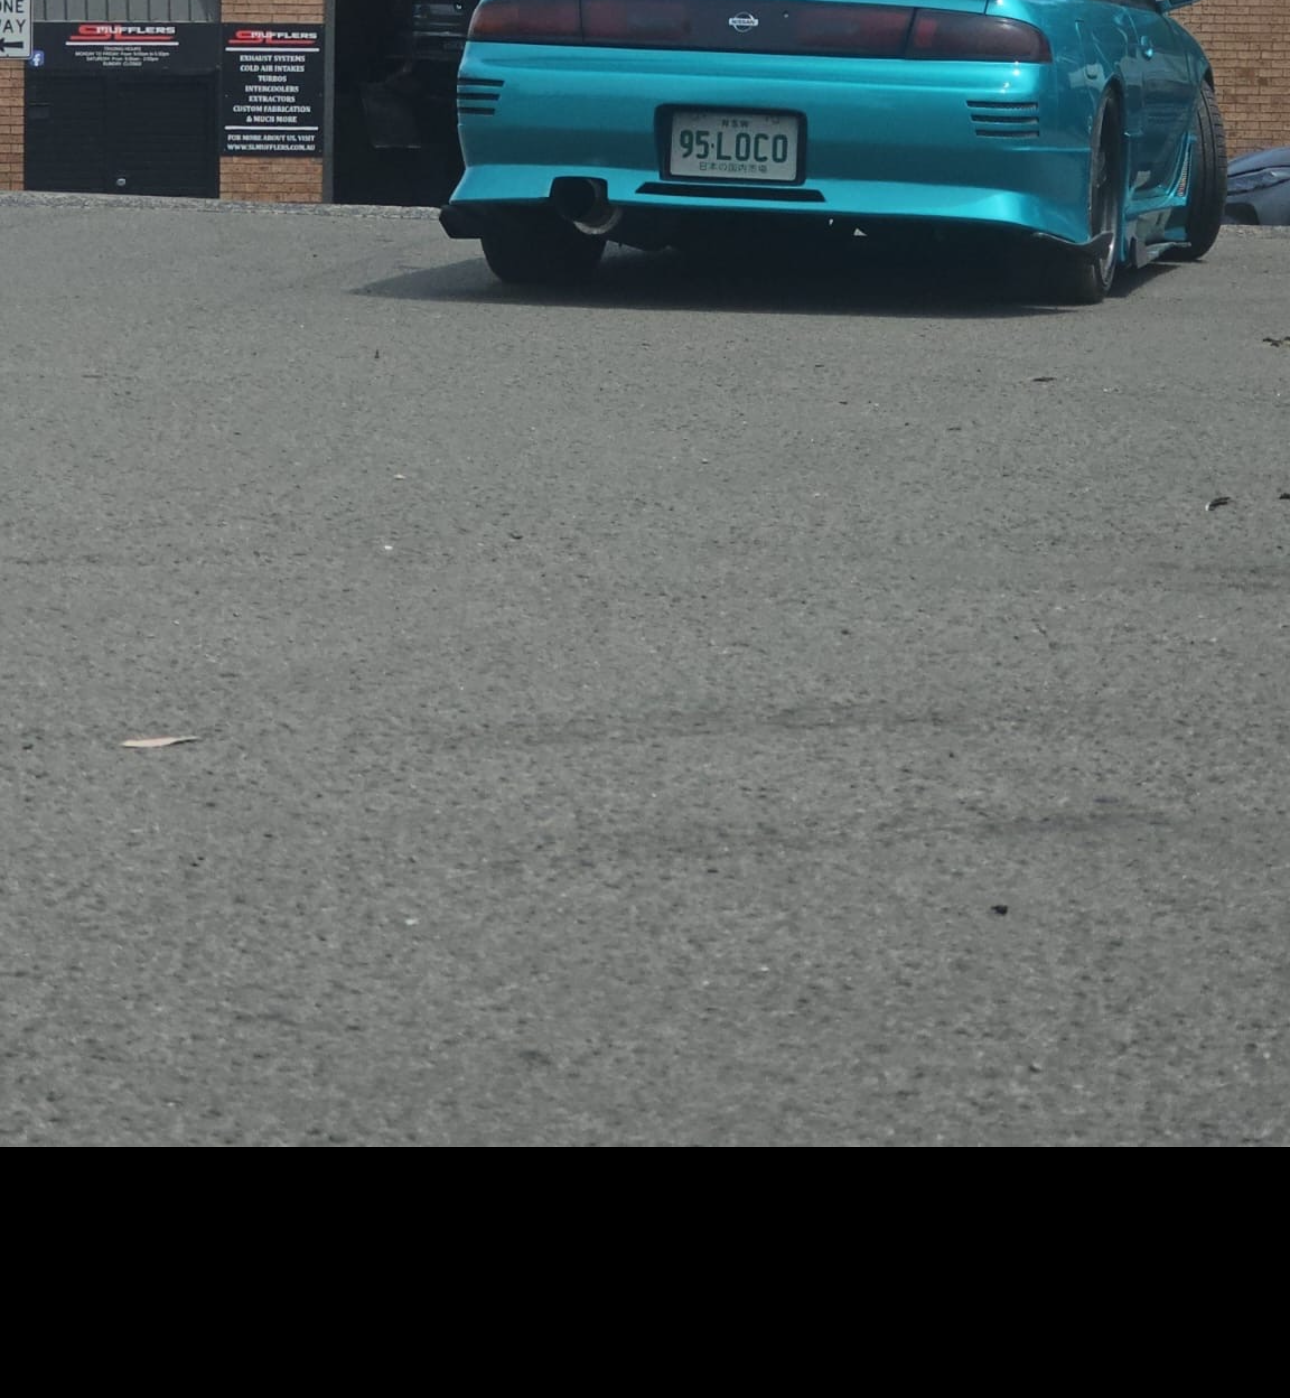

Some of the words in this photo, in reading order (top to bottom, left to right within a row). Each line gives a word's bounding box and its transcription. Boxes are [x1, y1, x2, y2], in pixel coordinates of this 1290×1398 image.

[96, 26, 176, 35] MUFFLERS
[250, 31, 318, 39] MUFFLERS
[263, 105, 311, 113] FABRICATION
[276, 115, 298, 123] MORE
[721, 119, 749, 128] NSW
